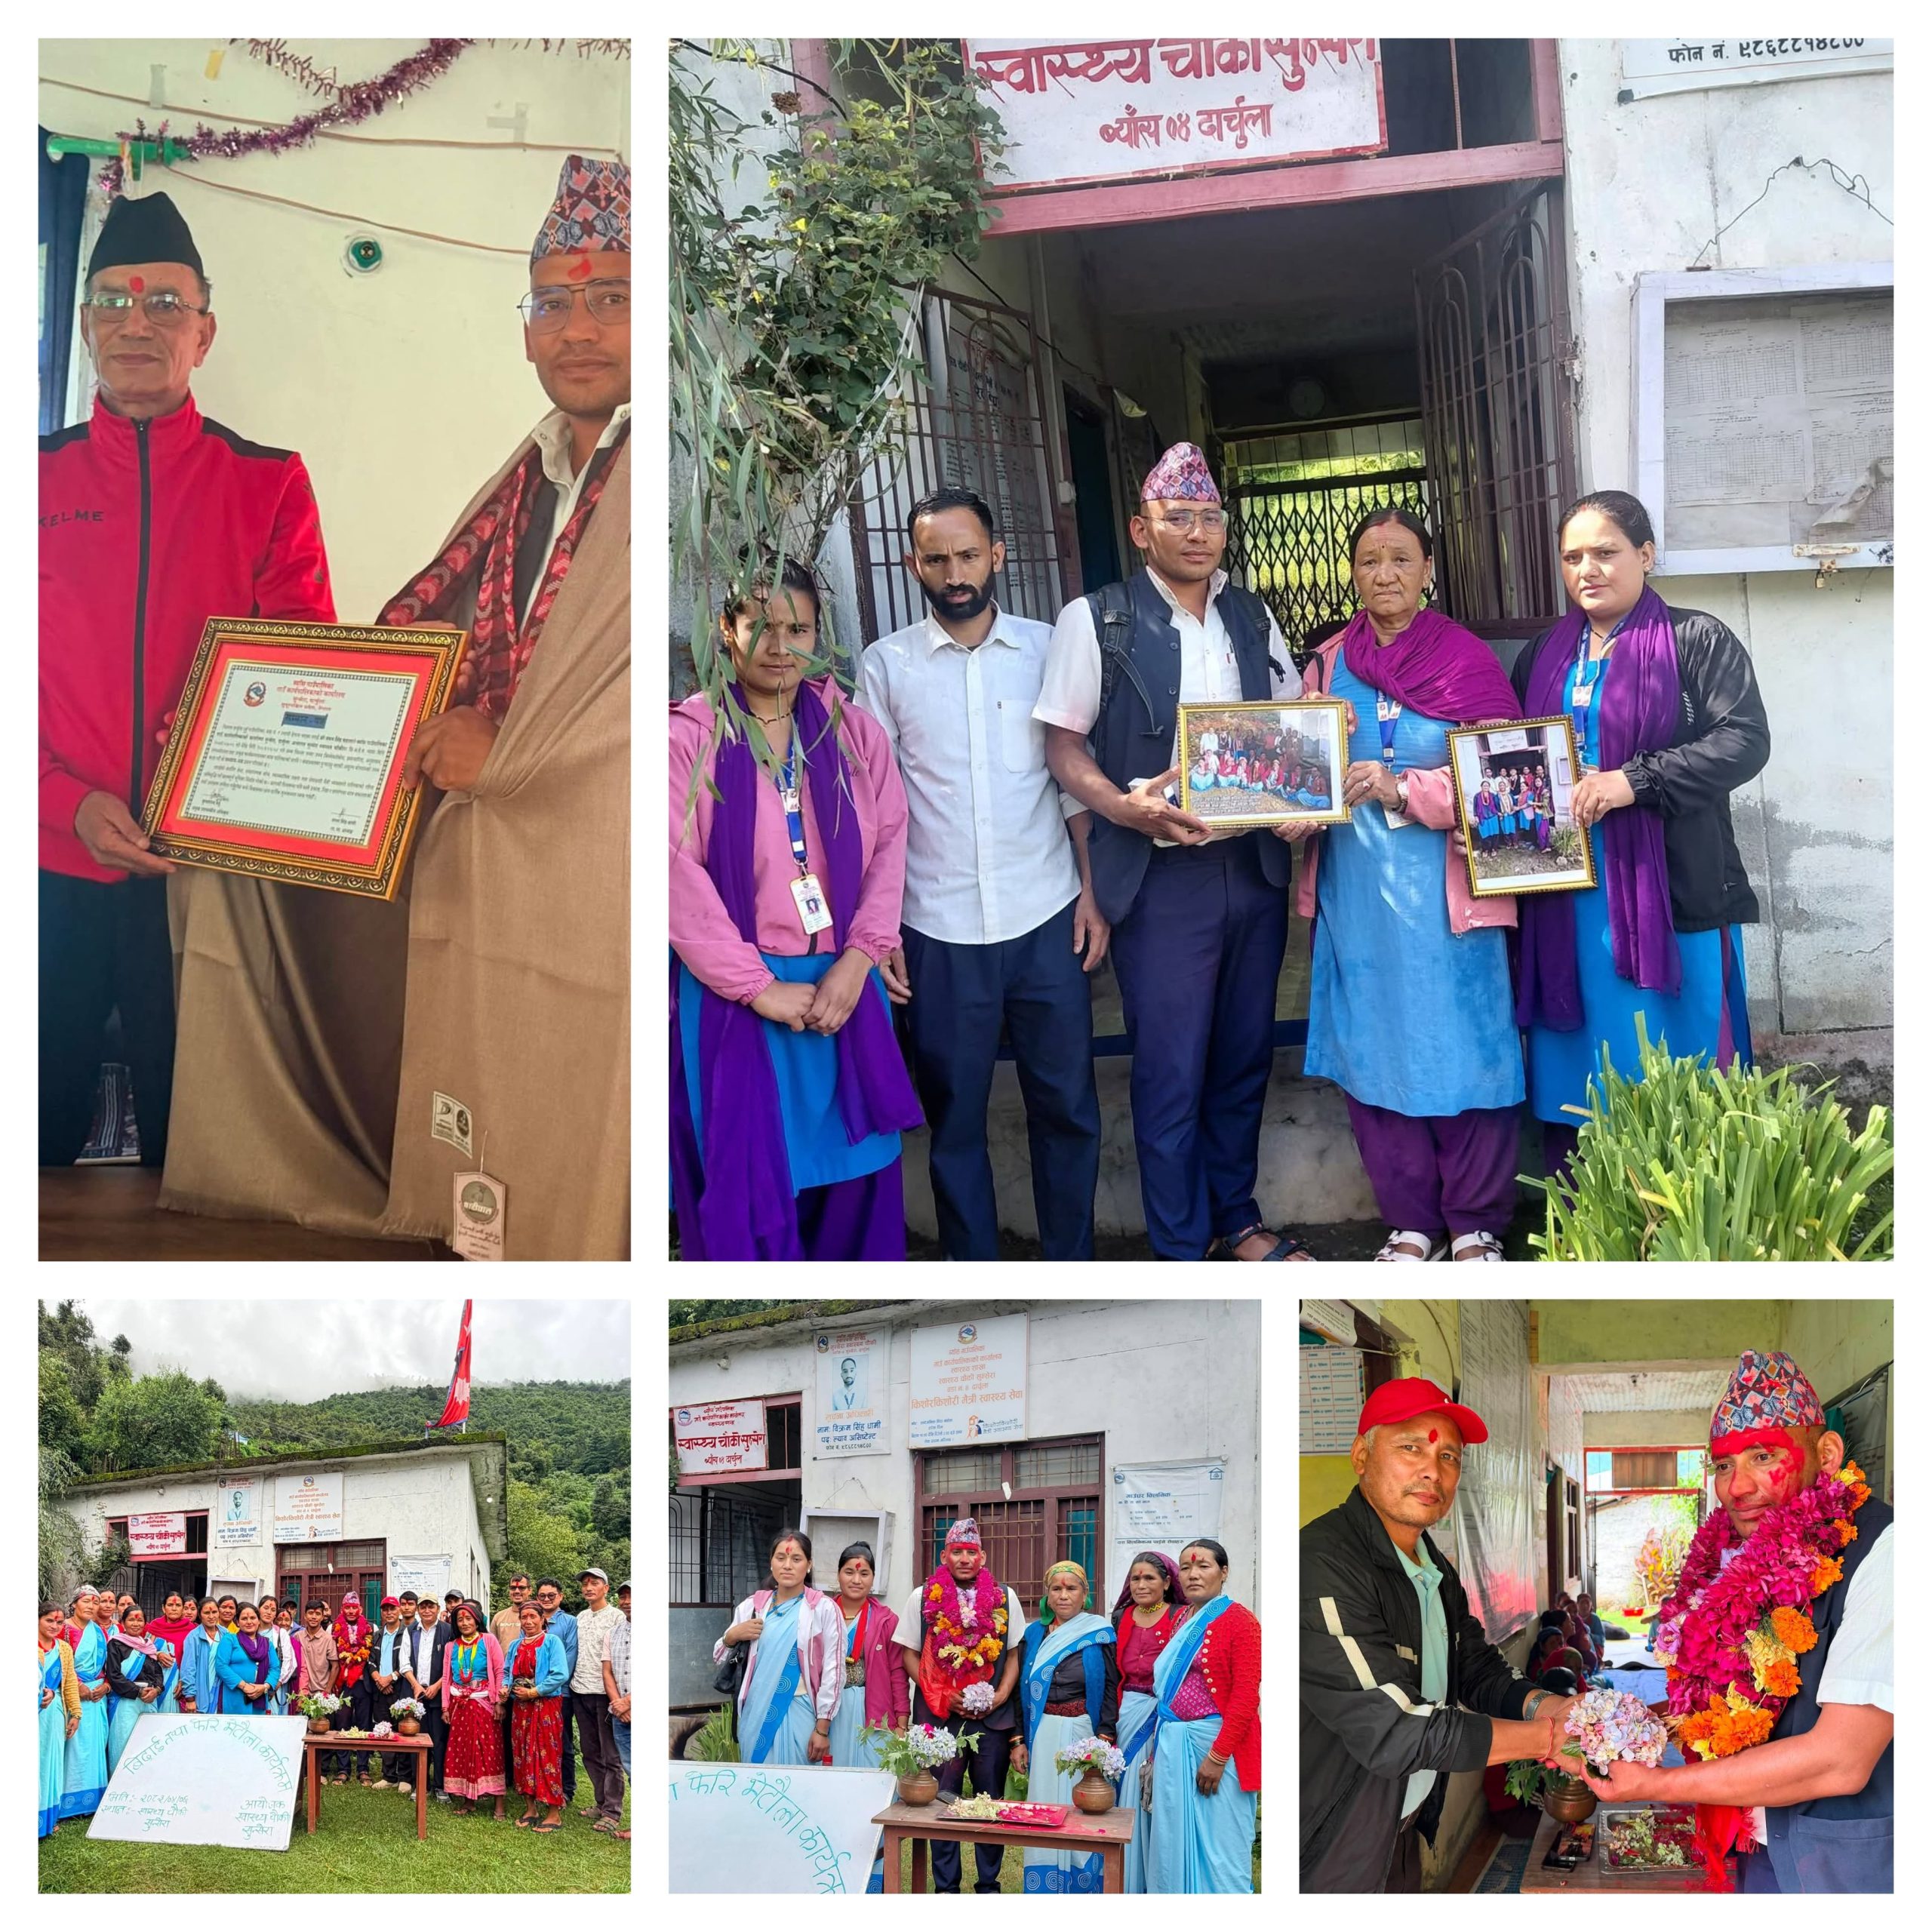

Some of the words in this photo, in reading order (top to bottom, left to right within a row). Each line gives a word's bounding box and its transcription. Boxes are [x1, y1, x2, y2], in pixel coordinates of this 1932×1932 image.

[1668, 44, 1704, 63] फोन
[1712, 40, 1729, 60] नं.
[975, 39, 1155, 103] स्वास्थ्य
[1263, 38, 1375, 91] सुन्सरा
[1166, 113, 1189, 141] ०४
[1197, 96, 1274, 149] दार्चुला
[38, 509, 105, 528] KELME
[912, 1395, 959, 1409] किशोरकिशोरी
[961, 1393, 977, 1404] मैत्री
[979, 1392, 1006, 1403] स्वास्थ्य
[1008, 1389, 1023, 1400] सेवा
[854, 1422, 865, 1431] सिंह
[868, 1420, 881, 1429] धामी
[678, 1437, 717, 1452] स्वास्थ्य
[718, 1431, 740, 1447] चौकी
[165, 1724, 188, 1746] तथा
[190, 1718, 220, 1732] फेरि
[259, 1744, 293, 1792] कार्यक्रम
[685, 1769, 737, 1796] फेरि
[241, 1795, 286, 1810] आयोजक
